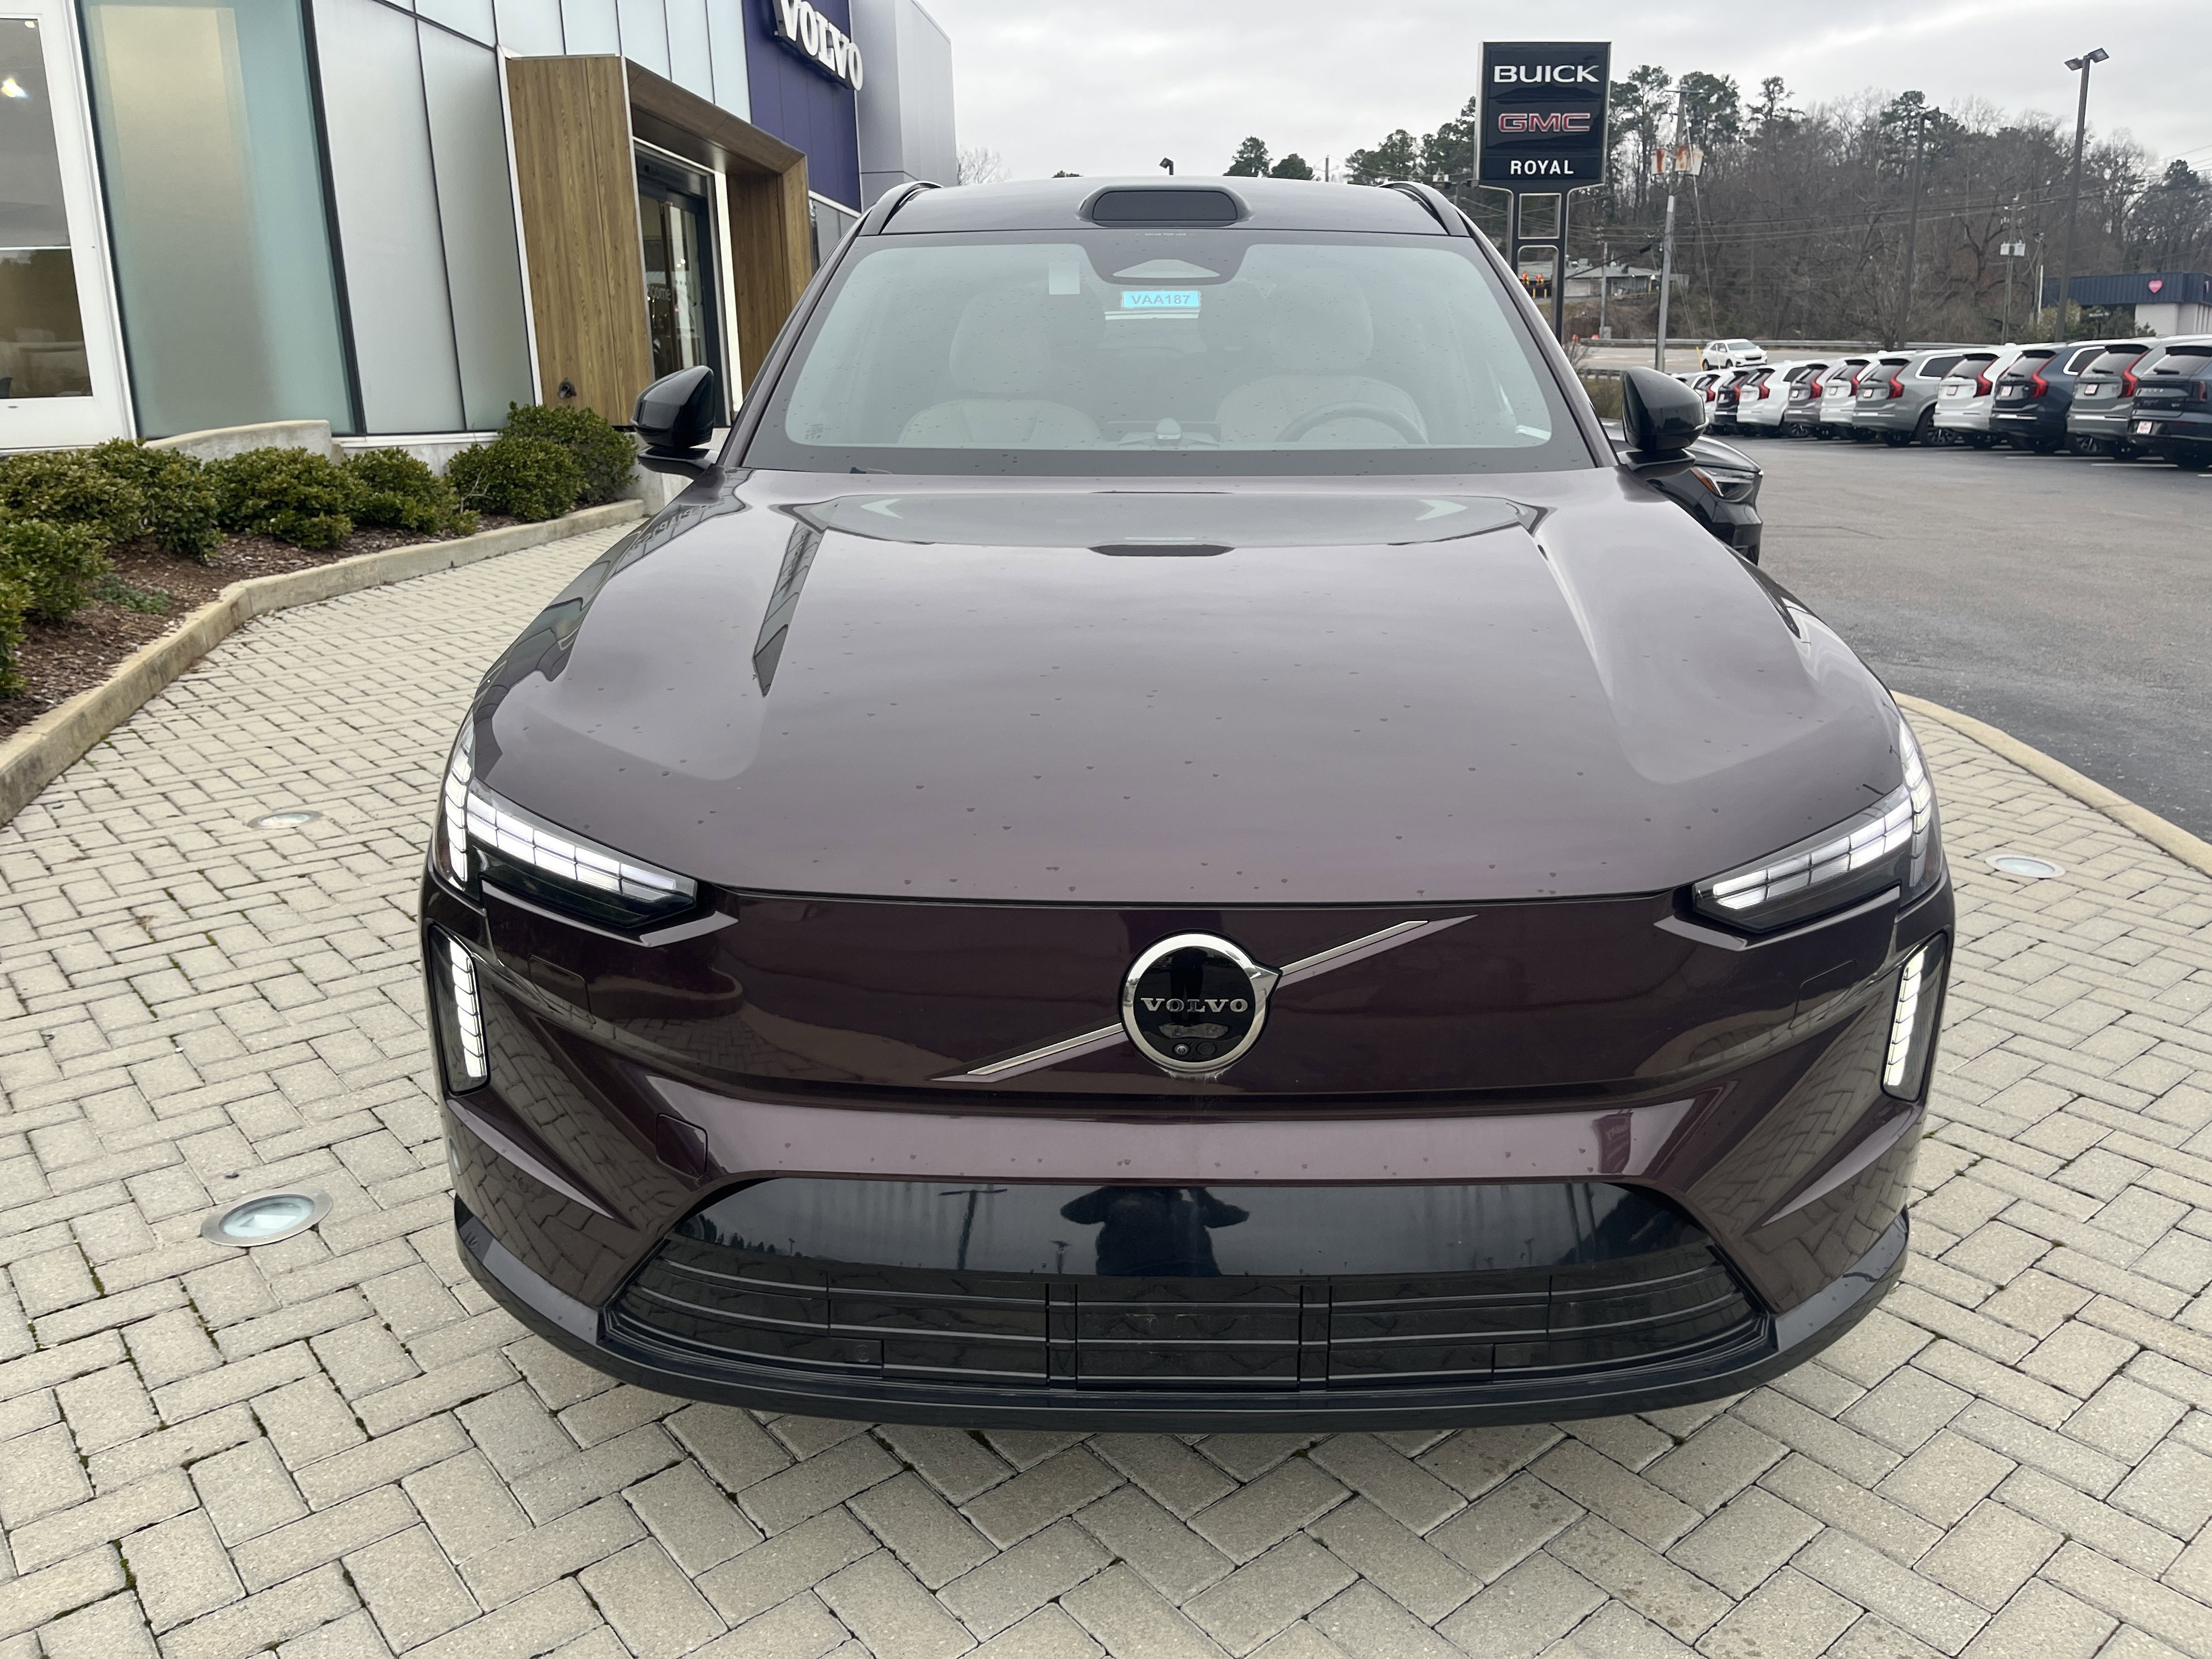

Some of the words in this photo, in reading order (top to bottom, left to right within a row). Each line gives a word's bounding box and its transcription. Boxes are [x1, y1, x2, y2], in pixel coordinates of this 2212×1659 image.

[781, 0, 863, 91] VOLVO
[1494, 65, 1599, 82] BUICK
[1498, 113, 1590, 132] GMC
[1510, 160, 1574, 175] ROYAL
[1131, 295, 1190, 304] VAA187
[1141, 997, 1249, 1012] VOLVO
